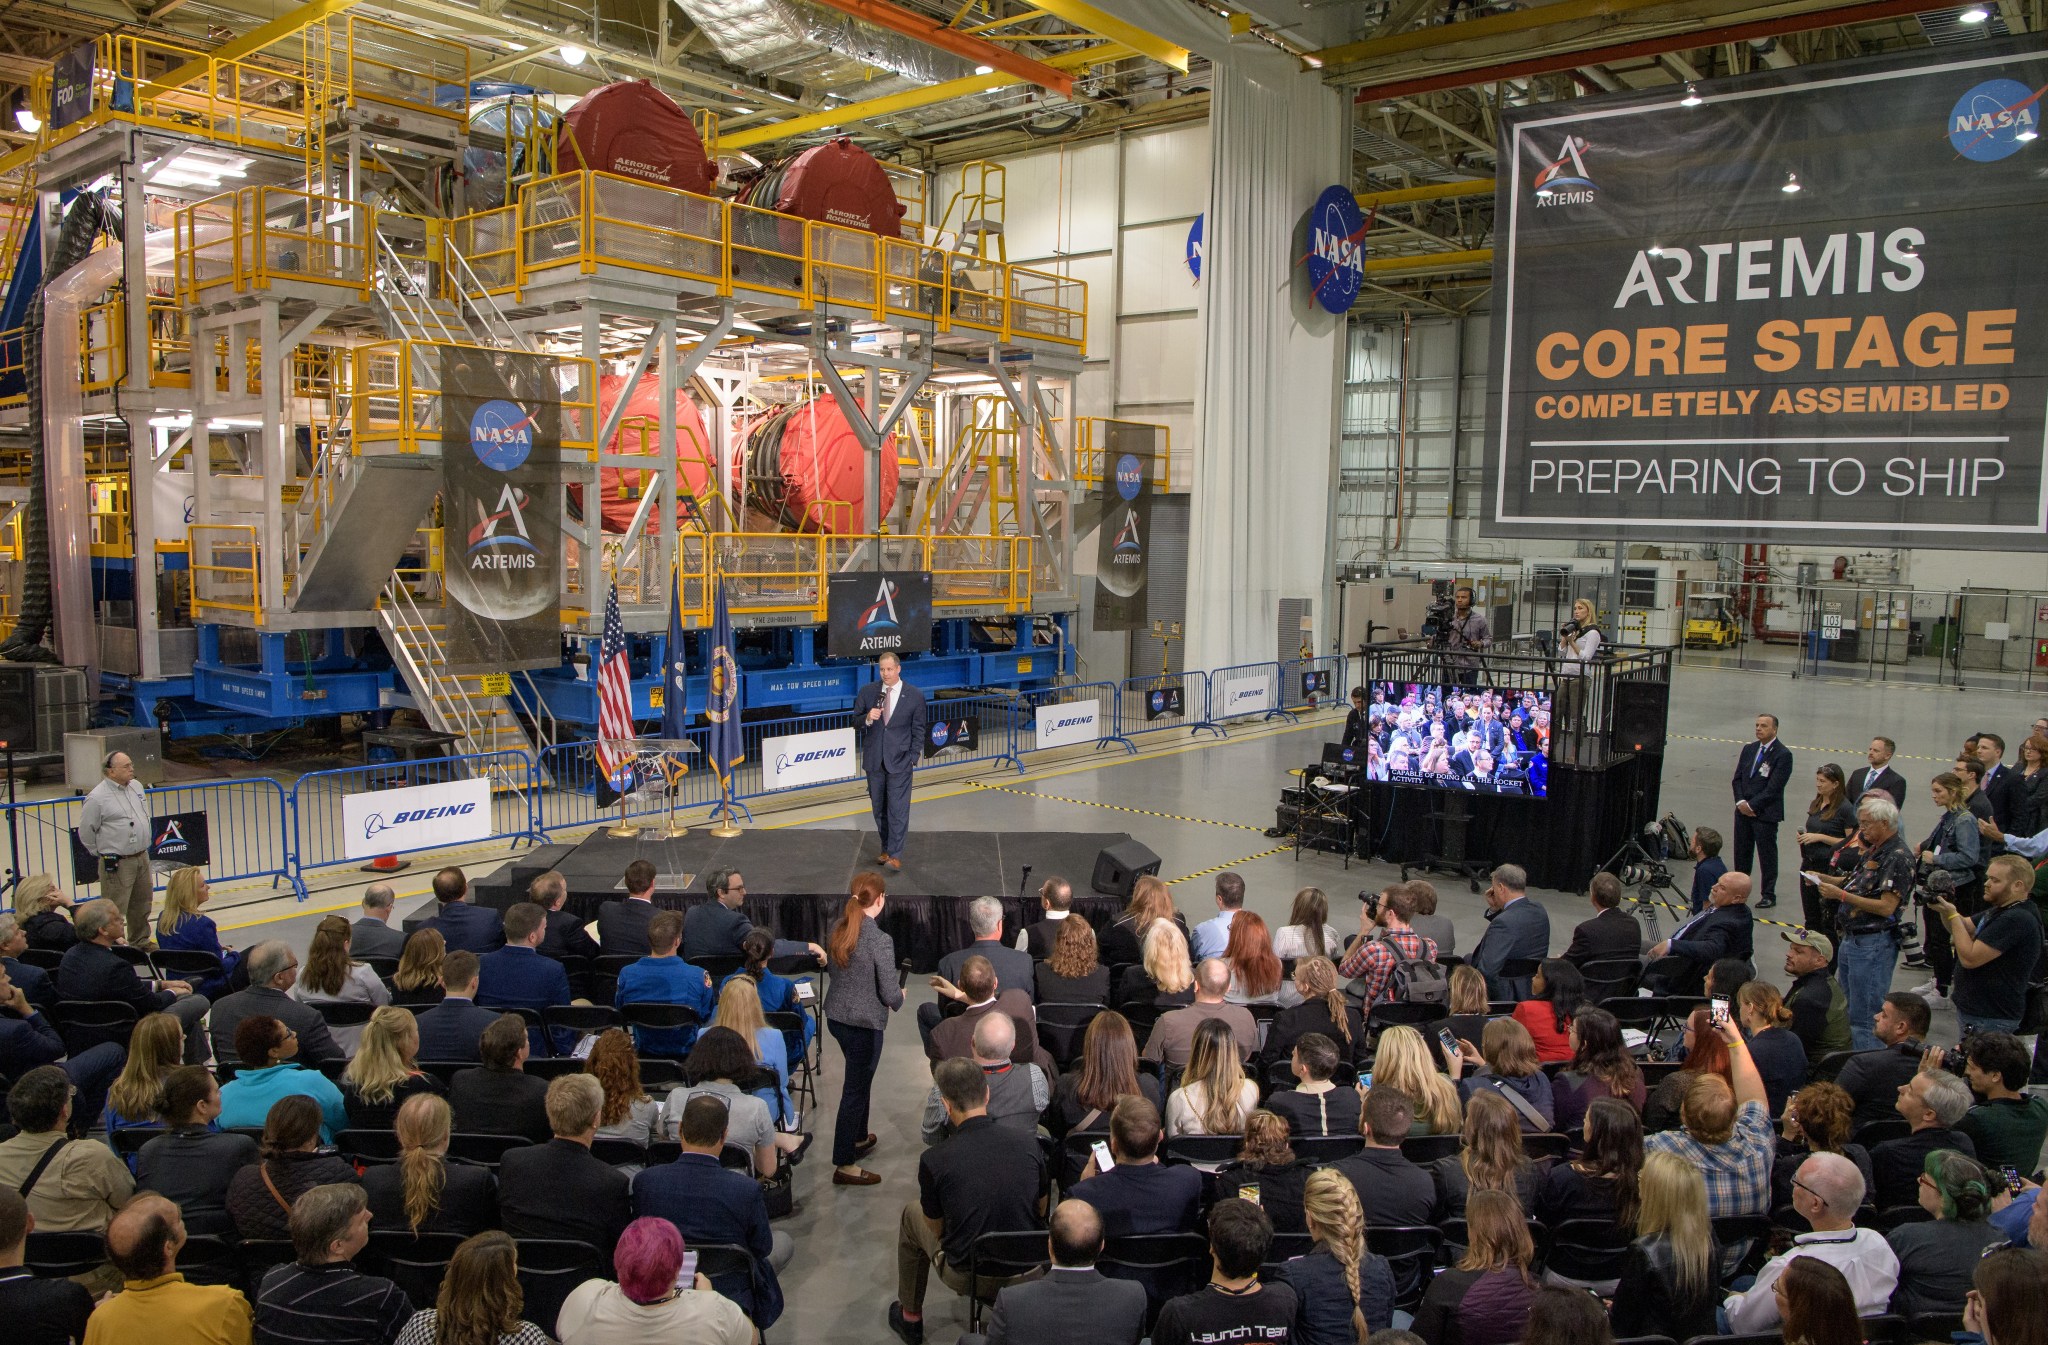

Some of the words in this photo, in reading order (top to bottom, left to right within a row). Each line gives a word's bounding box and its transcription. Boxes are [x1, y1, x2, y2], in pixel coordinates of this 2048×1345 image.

[57, 85, 74, 107] FOD
[1955, 108, 2033, 133] NASA
[614, 163, 671, 182] ROCKETDYNE
[615, 157, 659, 172] AEROJET
[1536, 190, 1594, 209] ARTEMIS
[825, 213, 871, 229] ROCKETDYNE
[827, 208, 861, 220] AEROJET
[1313, 227, 1364, 273] NASA
[1613, 227, 1926, 309] ARTEMIS
[1535, 323, 1729, 381] CORE
[1753, 308, 2018, 373] STAGE
[1534, 389, 1761, 420] COMPLETELY
[1768, 383, 2011, 415] ASSEMBLED
[475, 426, 529, 444] NASA
[1117, 471, 1141, 483] NASA
[1529, 457, 1782, 496] PREPARING
[1797, 457, 1867, 496] TO
[1882, 457, 2006, 497] SHIP
[471, 553, 536, 570] ARTEMIS
[1113, 553, 1141, 564] ARTEMIS
[1826, 615, 1840, 626] 103
[860, 635, 902, 650] ARTEMIS
[787, 682, 800, 690] TOW
[802, 680, 822, 689] SPEED
[1238, 688, 1264, 699] BOEING
[1057, 715, 1093, 728] BOEING
[932, 730, 948, 738] NASA
[793, 747, 846, 763] BOEING
[1391, 769, 1423, 778] CAPABLE
[1436, 773, 1460, 781] DOING
[1461, 775, 1475, 783] ALL
[1493, 778, 1523, 787] ROCKET
[1391, 775, 1425, 784] ACTIVITY.
[392, 802, 476, 825] BOEING
[157, 844, 188, 855] ARTEMIS
[1190, 1324, 1252, 1344] Launch
[1254, 1325, 1288, 1338] Team
